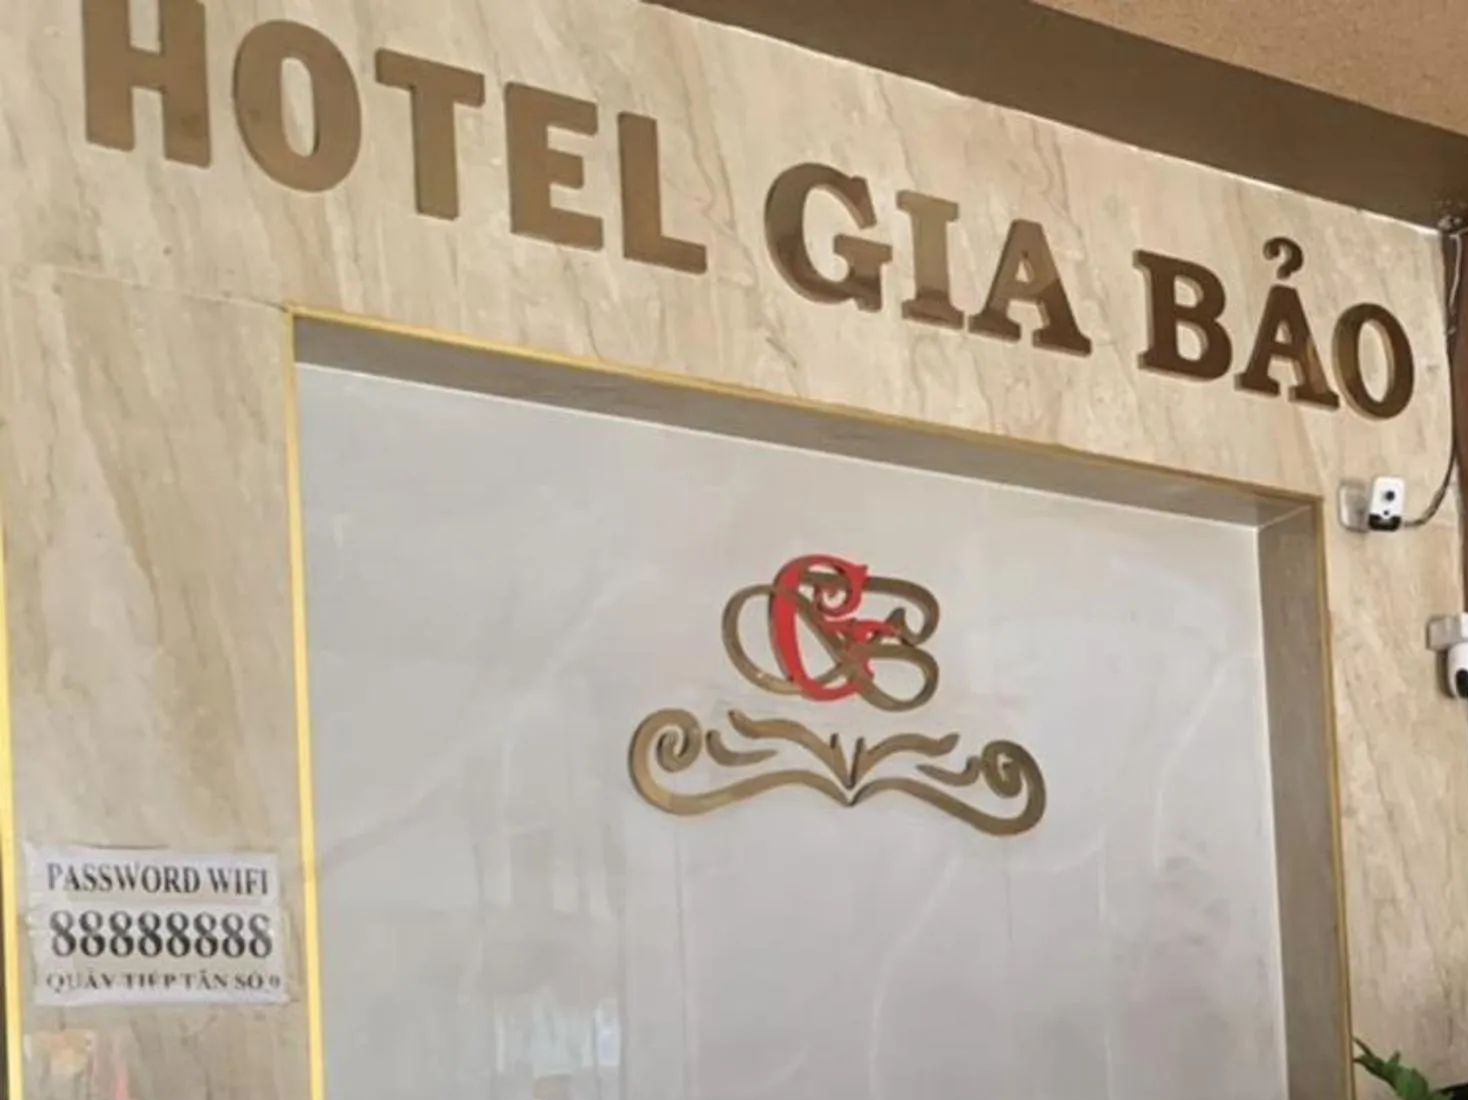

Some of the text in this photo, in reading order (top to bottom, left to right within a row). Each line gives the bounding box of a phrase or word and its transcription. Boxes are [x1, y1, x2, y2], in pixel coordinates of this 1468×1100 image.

[82, 0, 1415, 420] HOTEL GIA BẢO
[47, 863, 268, 896] PASSWORD WIFI
[50, 909, 273, 959] 88888888
